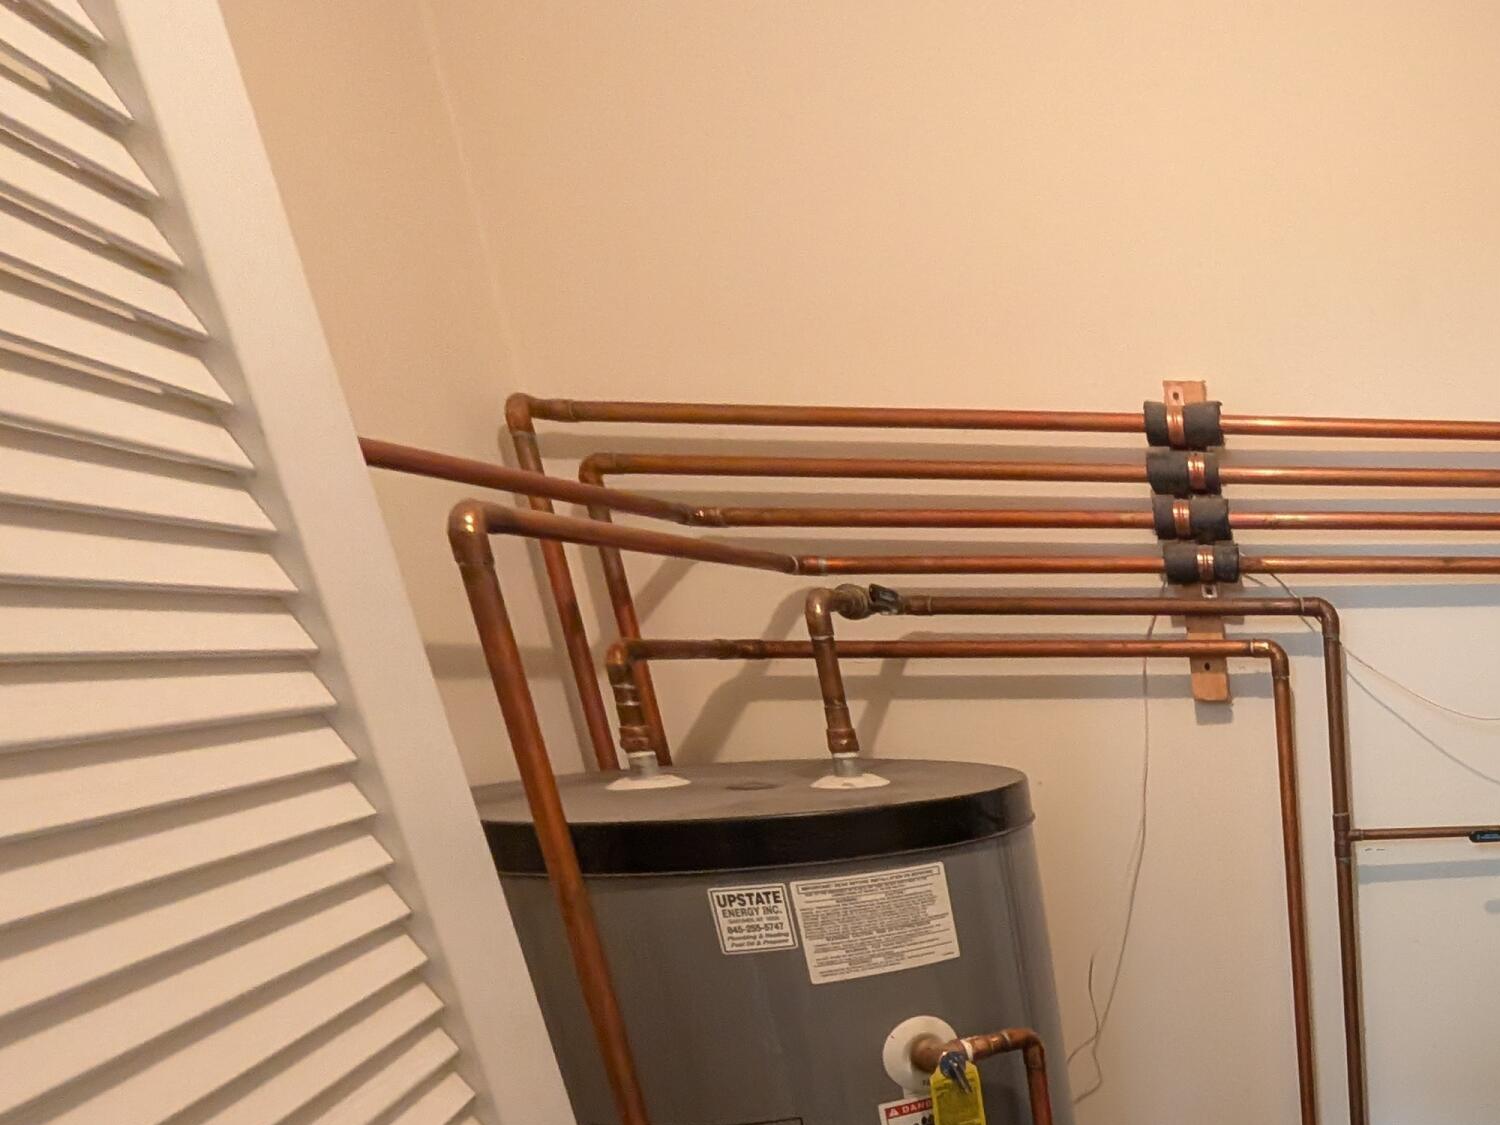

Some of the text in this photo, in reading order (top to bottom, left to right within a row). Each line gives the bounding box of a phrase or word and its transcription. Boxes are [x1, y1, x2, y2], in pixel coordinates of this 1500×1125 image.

[715, 891, 782, 908] UPSTATE
[722, 905, 783, 918] ENERGY INC.
